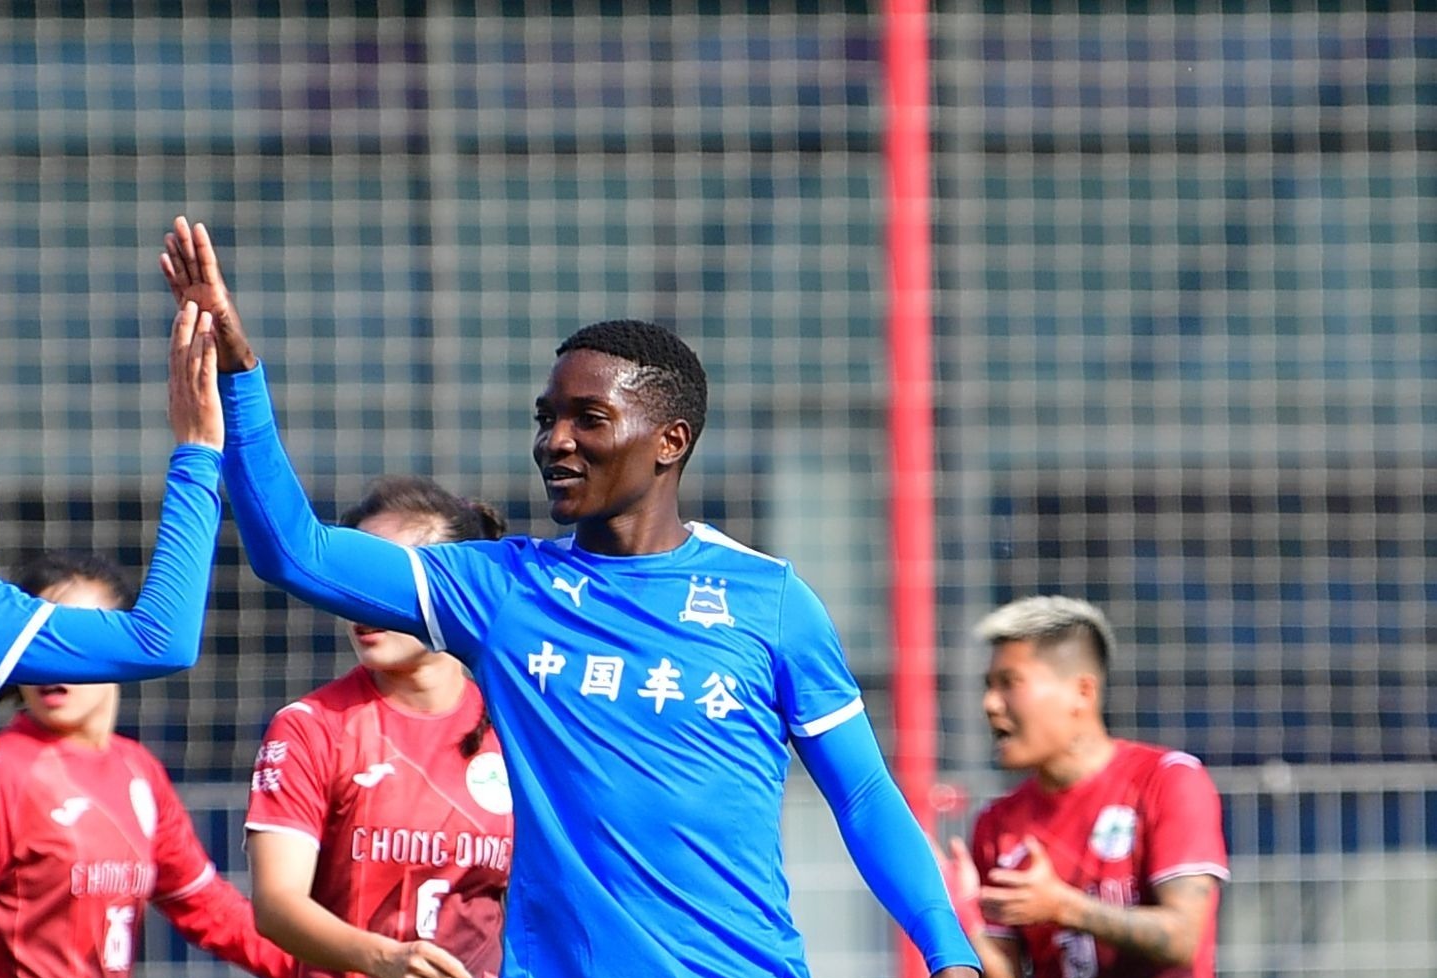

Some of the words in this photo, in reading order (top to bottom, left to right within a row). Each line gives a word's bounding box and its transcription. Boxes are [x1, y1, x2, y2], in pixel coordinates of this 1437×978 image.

[527, 641, 744, 719] 中国车谷
[352, 827, 448, 867] CHONG
[416, 878, 451, 939] 6
